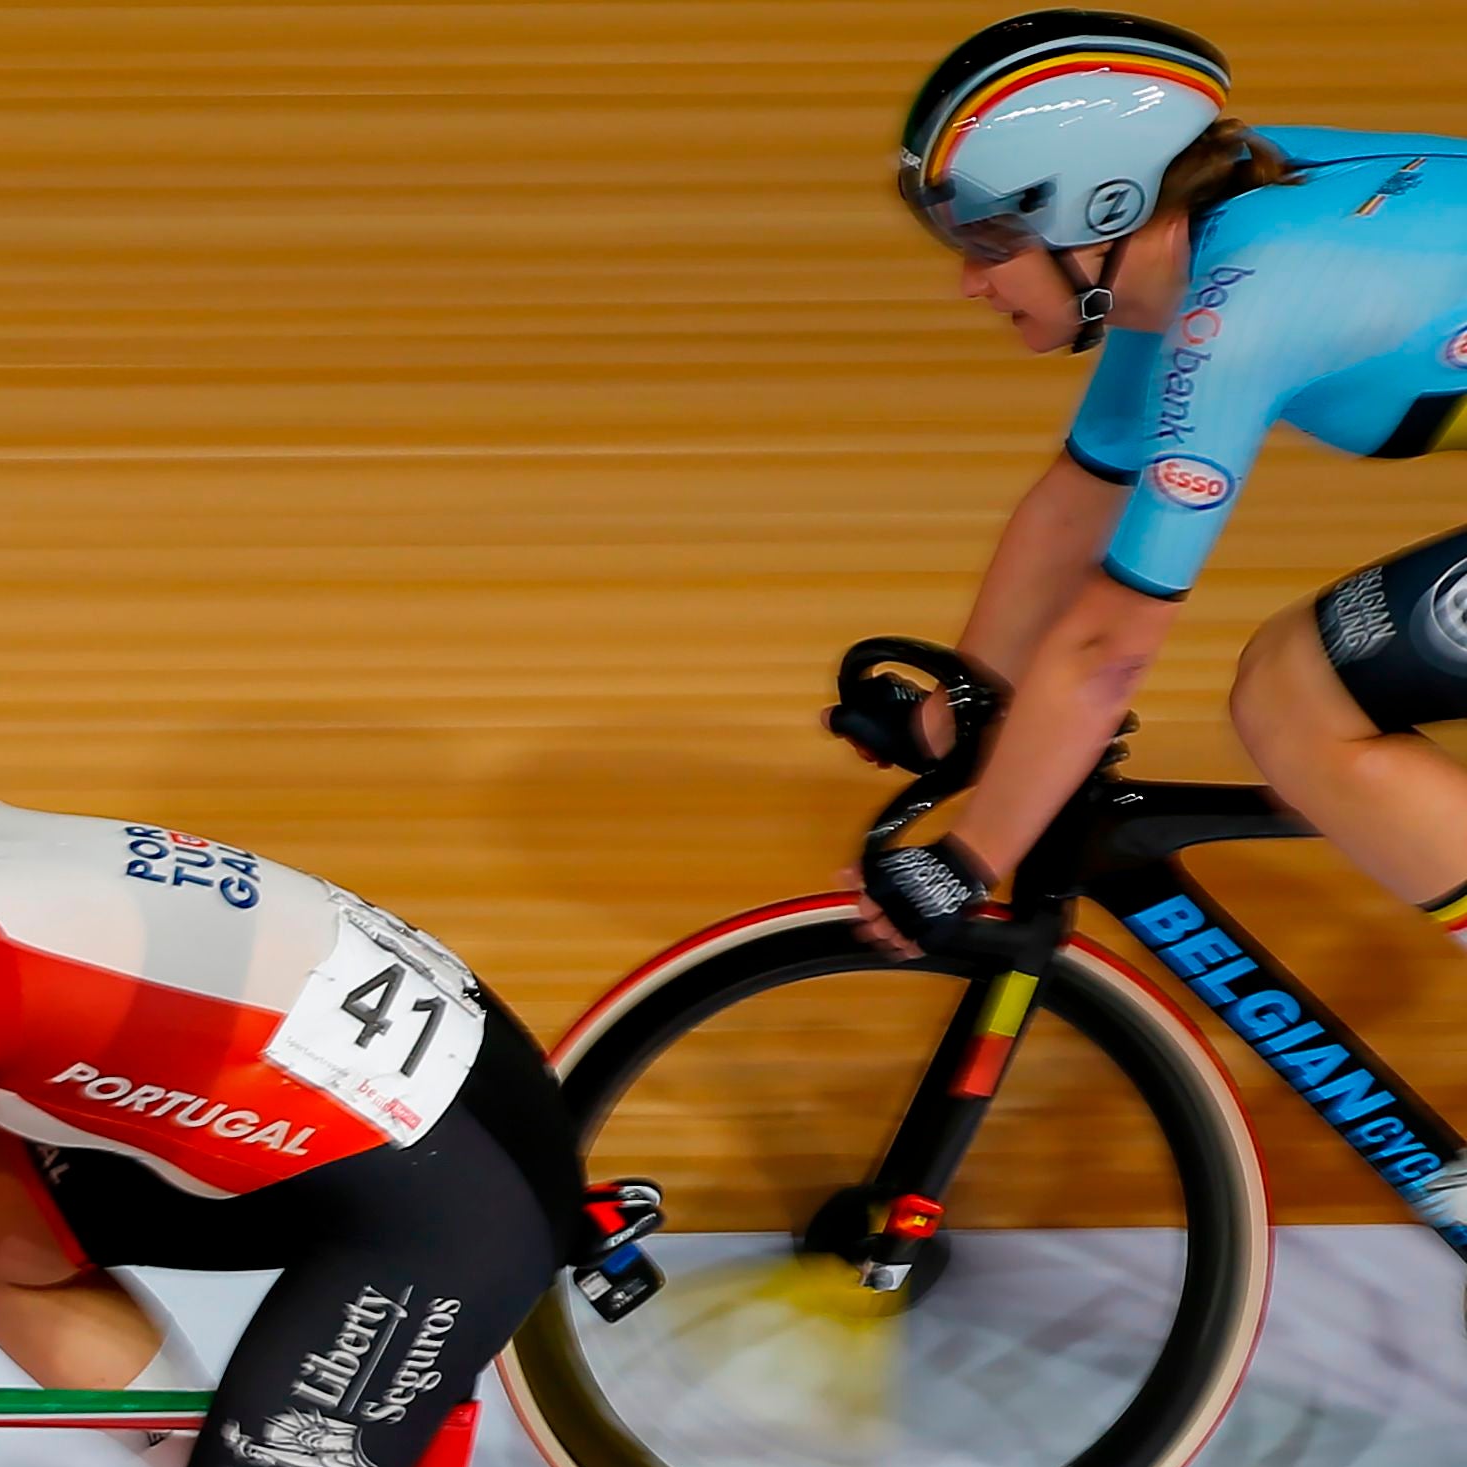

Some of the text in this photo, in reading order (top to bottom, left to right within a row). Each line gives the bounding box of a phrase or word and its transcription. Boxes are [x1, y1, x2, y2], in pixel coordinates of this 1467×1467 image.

[124, 826, 169, 883] POR
[219, 846, 261, 909] GAL
[340, 962, 449, 1078] 41
[1123, 894, 1397, 1127] BELGIAN
[47, 1060, 316, 1156] PORTUGAL
[293, 1285, 409, 1408] Liberty
[366, 1296, 462, 1425] Seguros
